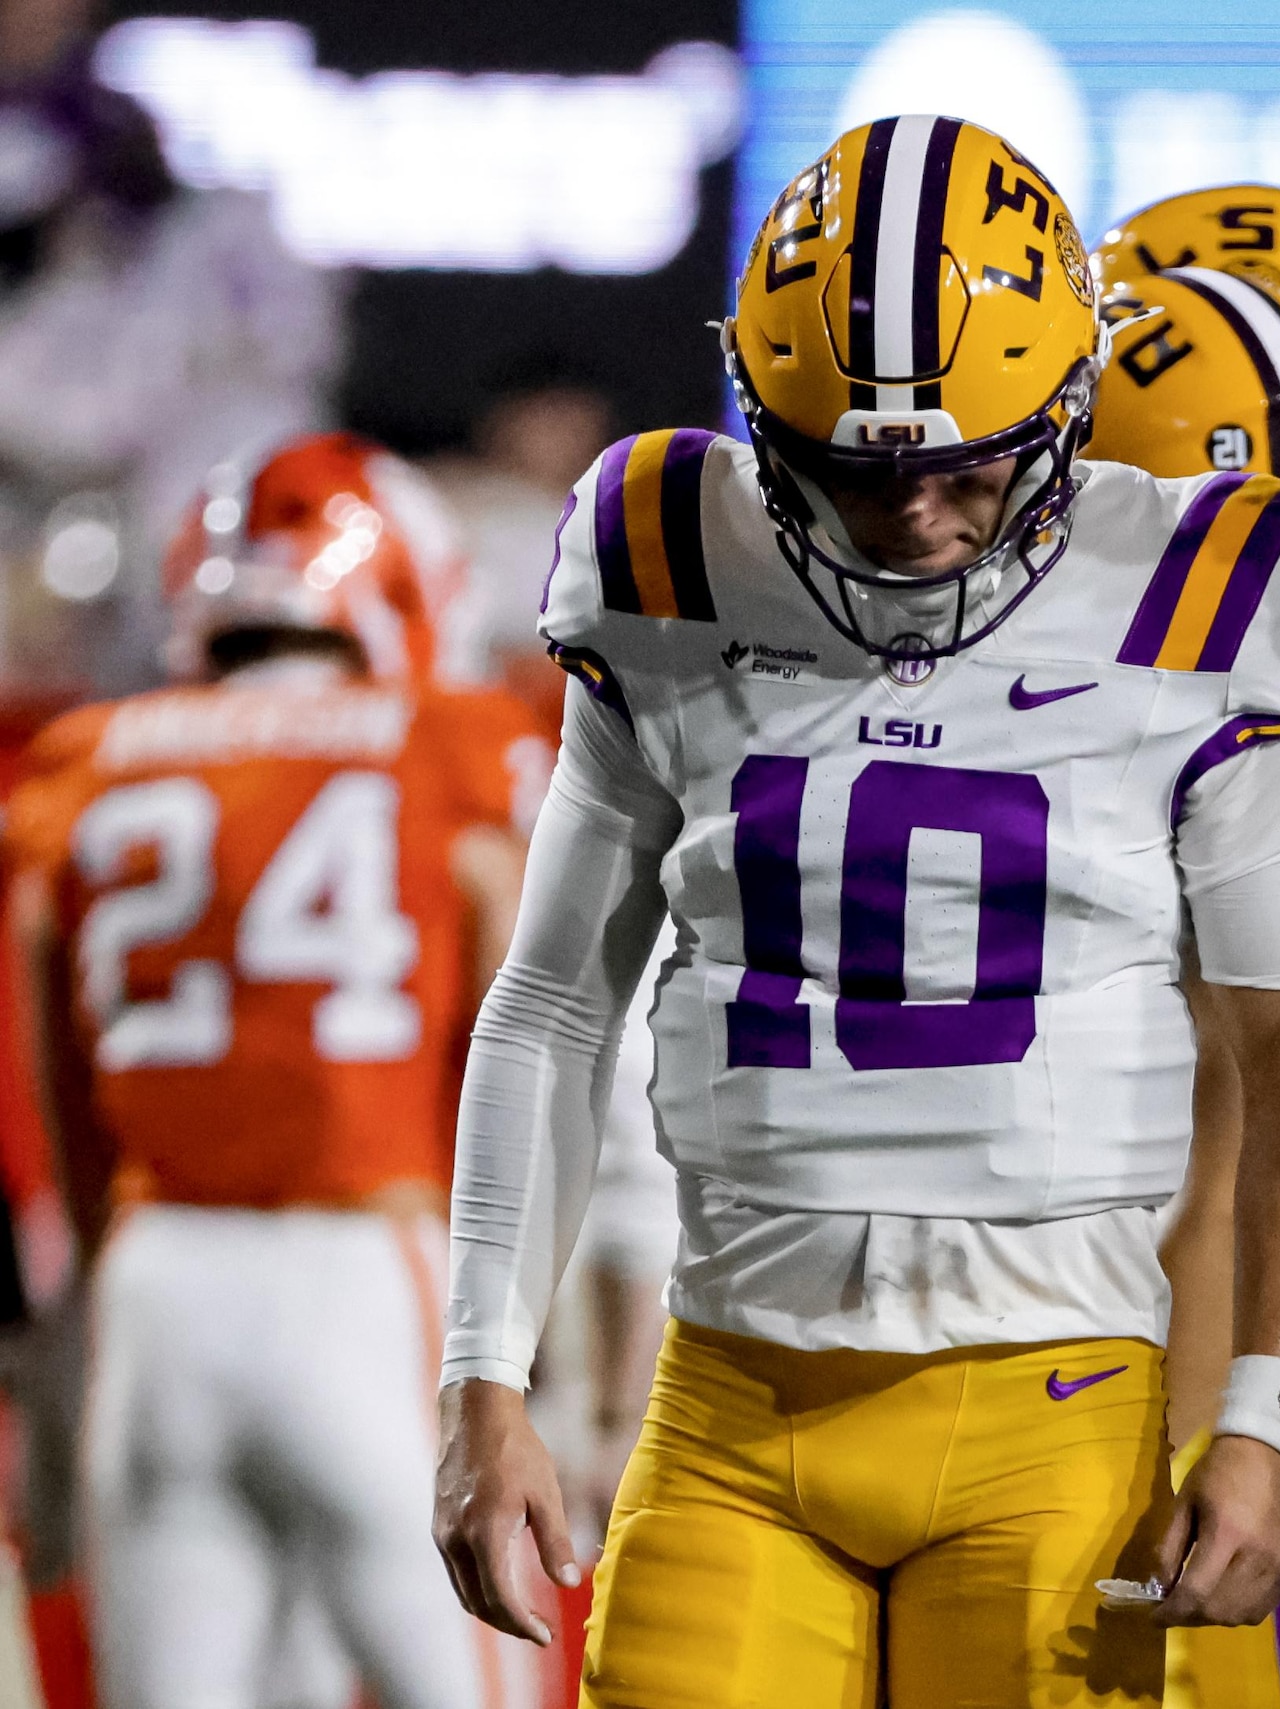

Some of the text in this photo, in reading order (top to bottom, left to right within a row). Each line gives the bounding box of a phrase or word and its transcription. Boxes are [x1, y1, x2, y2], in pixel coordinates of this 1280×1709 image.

[858, 424, 926, 446] LSU
[1212, 428, 1249, 471] 21
[753, 643, 818, 663] Woodside
[752, 660, 800, 680] Energy
[858, 716, 943, 749] LSU
[72, 770, 422, 1070] 24
[725, 754, 1050, 1071] 10
